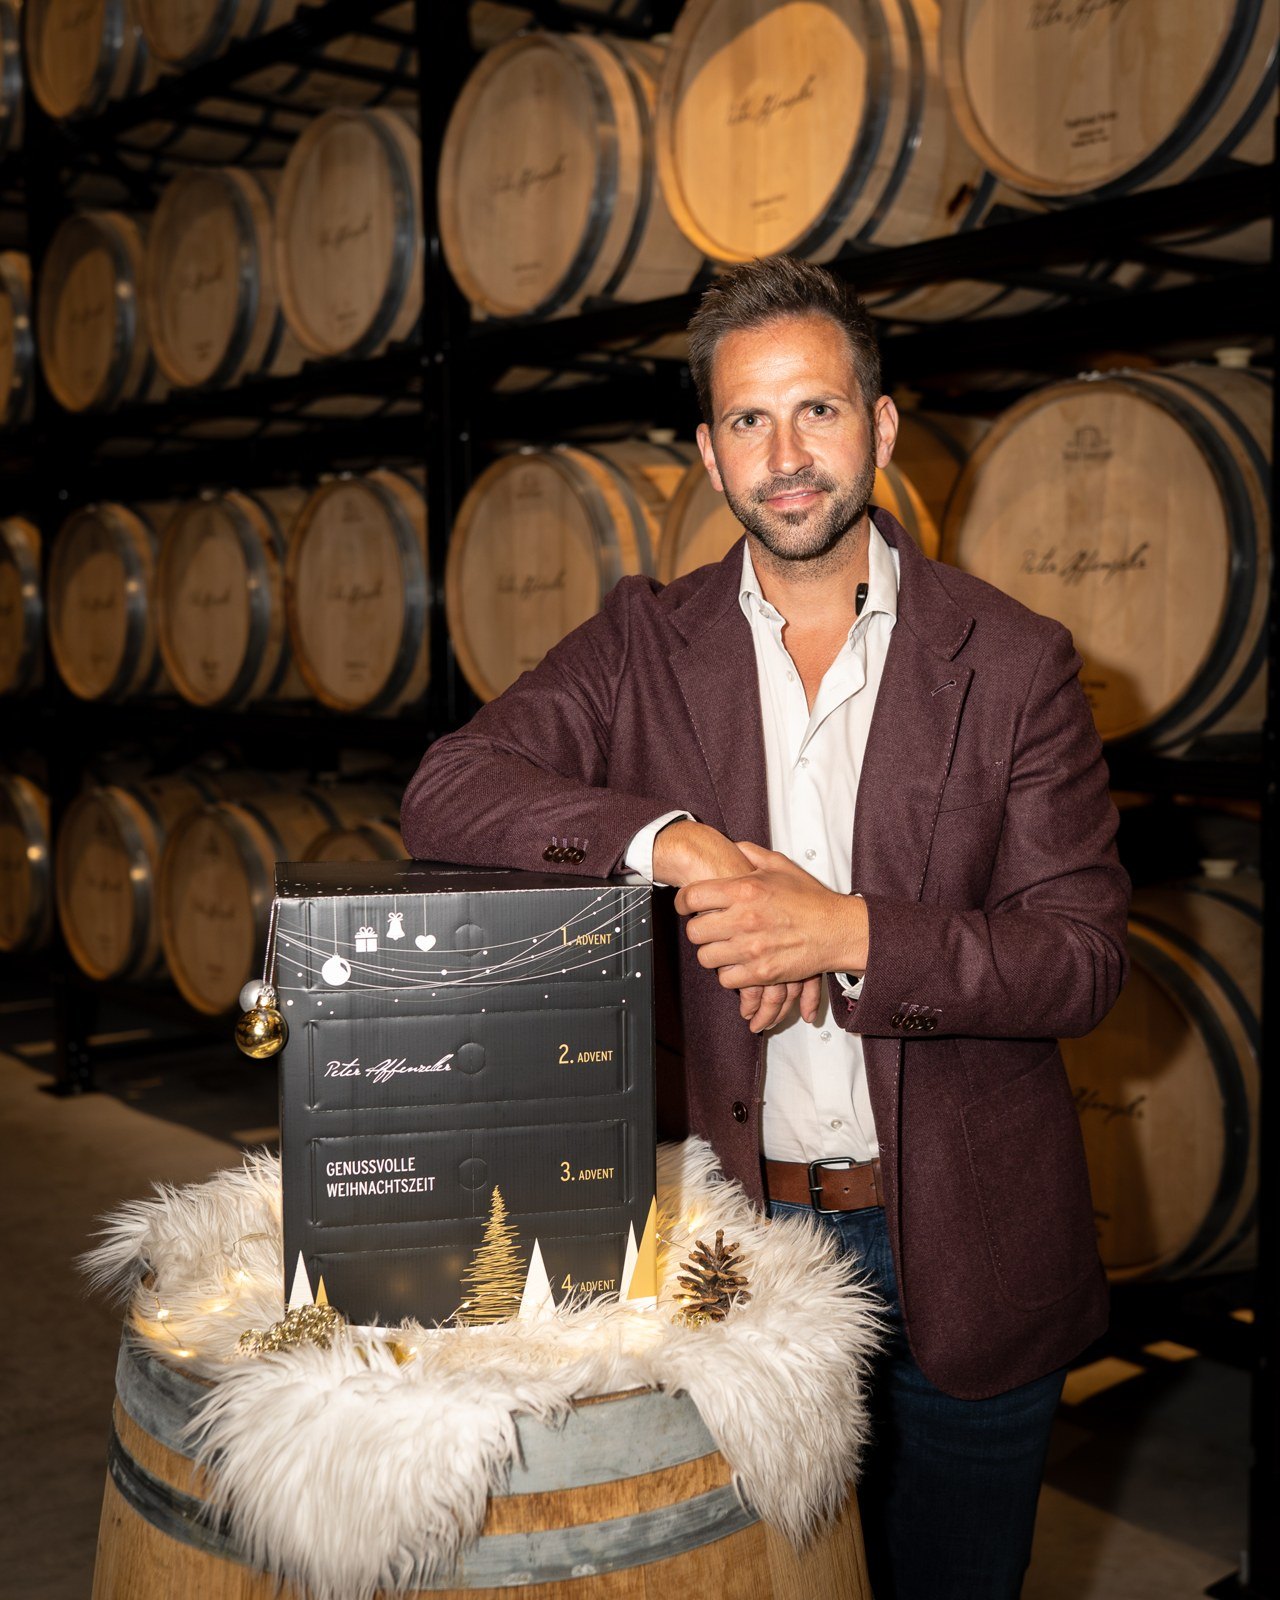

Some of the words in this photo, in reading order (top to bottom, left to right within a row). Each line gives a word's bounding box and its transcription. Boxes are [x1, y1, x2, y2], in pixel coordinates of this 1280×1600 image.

[575, 933, 612, 946] ADVENT
[559, 1043, 574, 1064] 2.
[577, 1050, 614, 1063] ADVENT
[324, 1058, 361, 1077] Peter
[326, 1156, 416, 1177] GENUSSVOLLE
[560, 1161, 576, 1182] 3.
[578, 1167, 615, 1181] ADVENT
[326, 1177, 436, 1198] WEIHNACHTSZEIT
[580, 1279, 616, 1293] ADVENT
